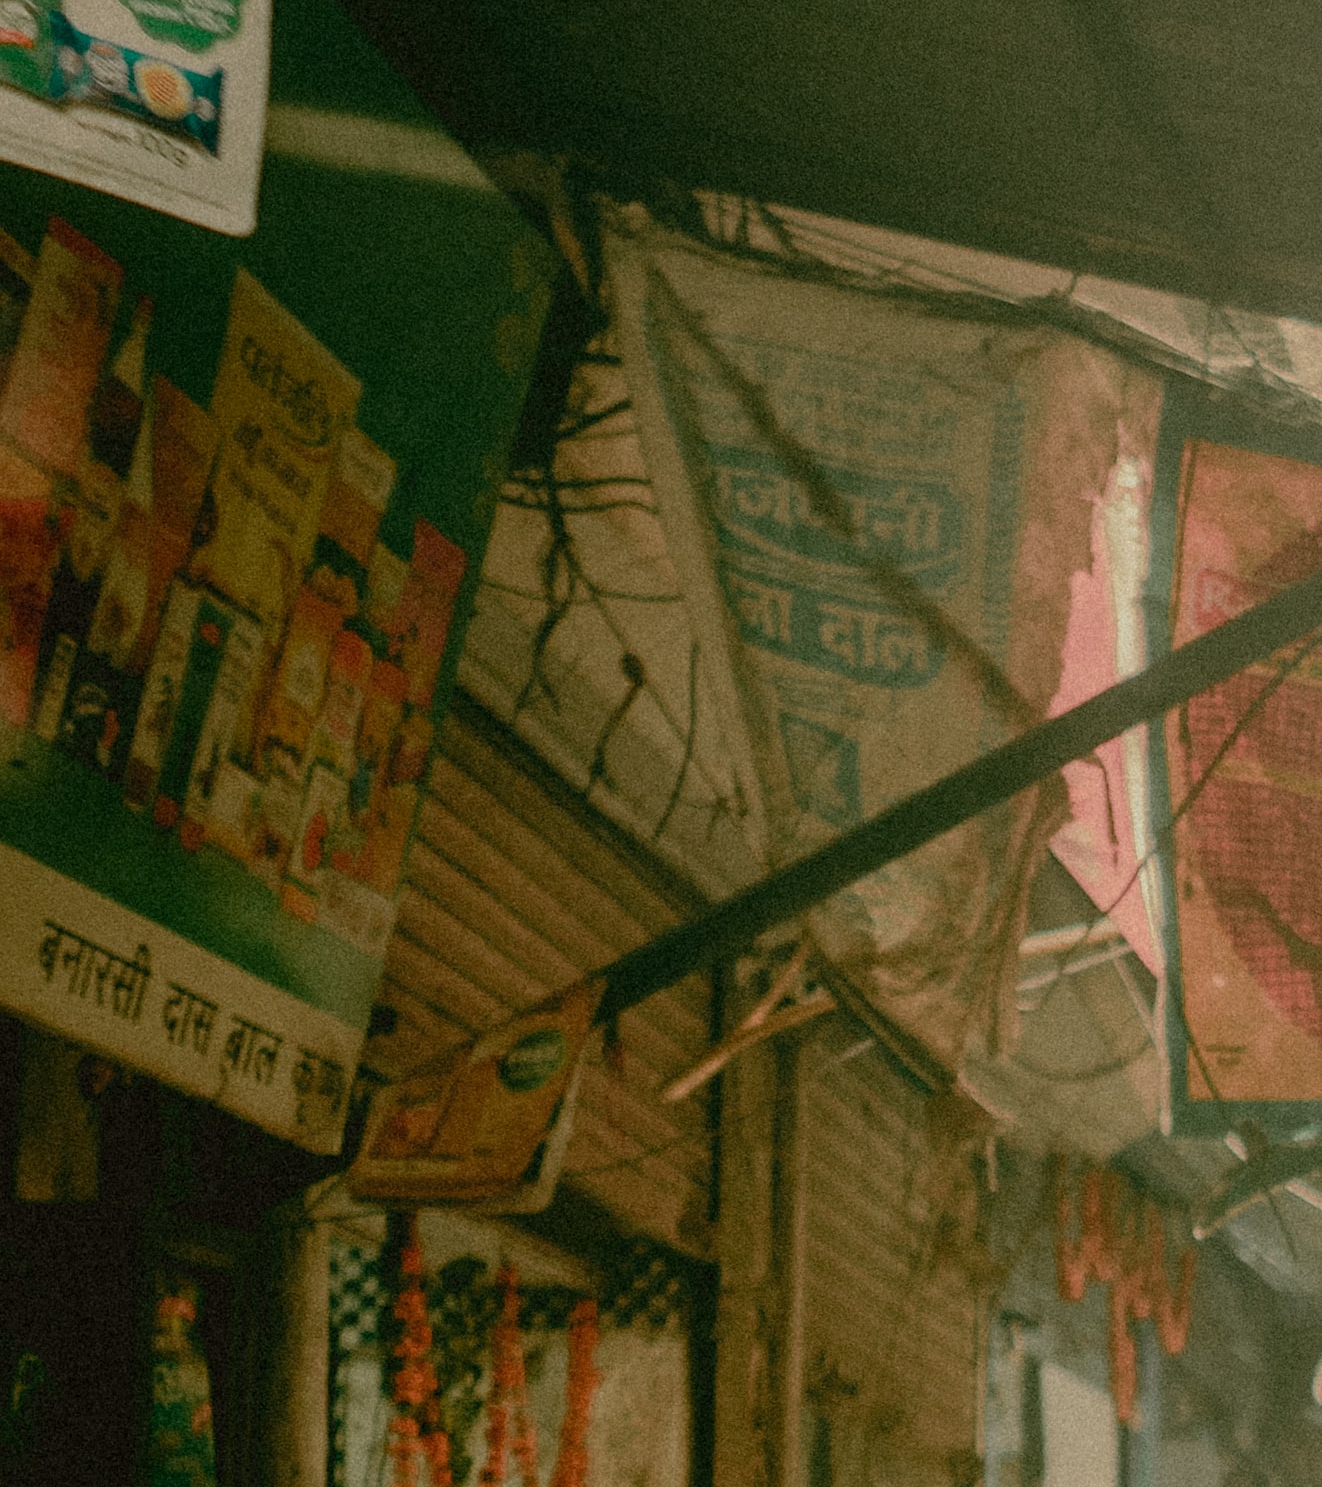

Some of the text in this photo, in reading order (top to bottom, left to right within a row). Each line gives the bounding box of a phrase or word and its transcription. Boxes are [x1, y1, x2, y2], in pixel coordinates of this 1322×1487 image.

[39, 920, 152, 1027] बनारसी
[163, 980, 220, 1057] दास
[225, 1013, 285, 1086] बाल
